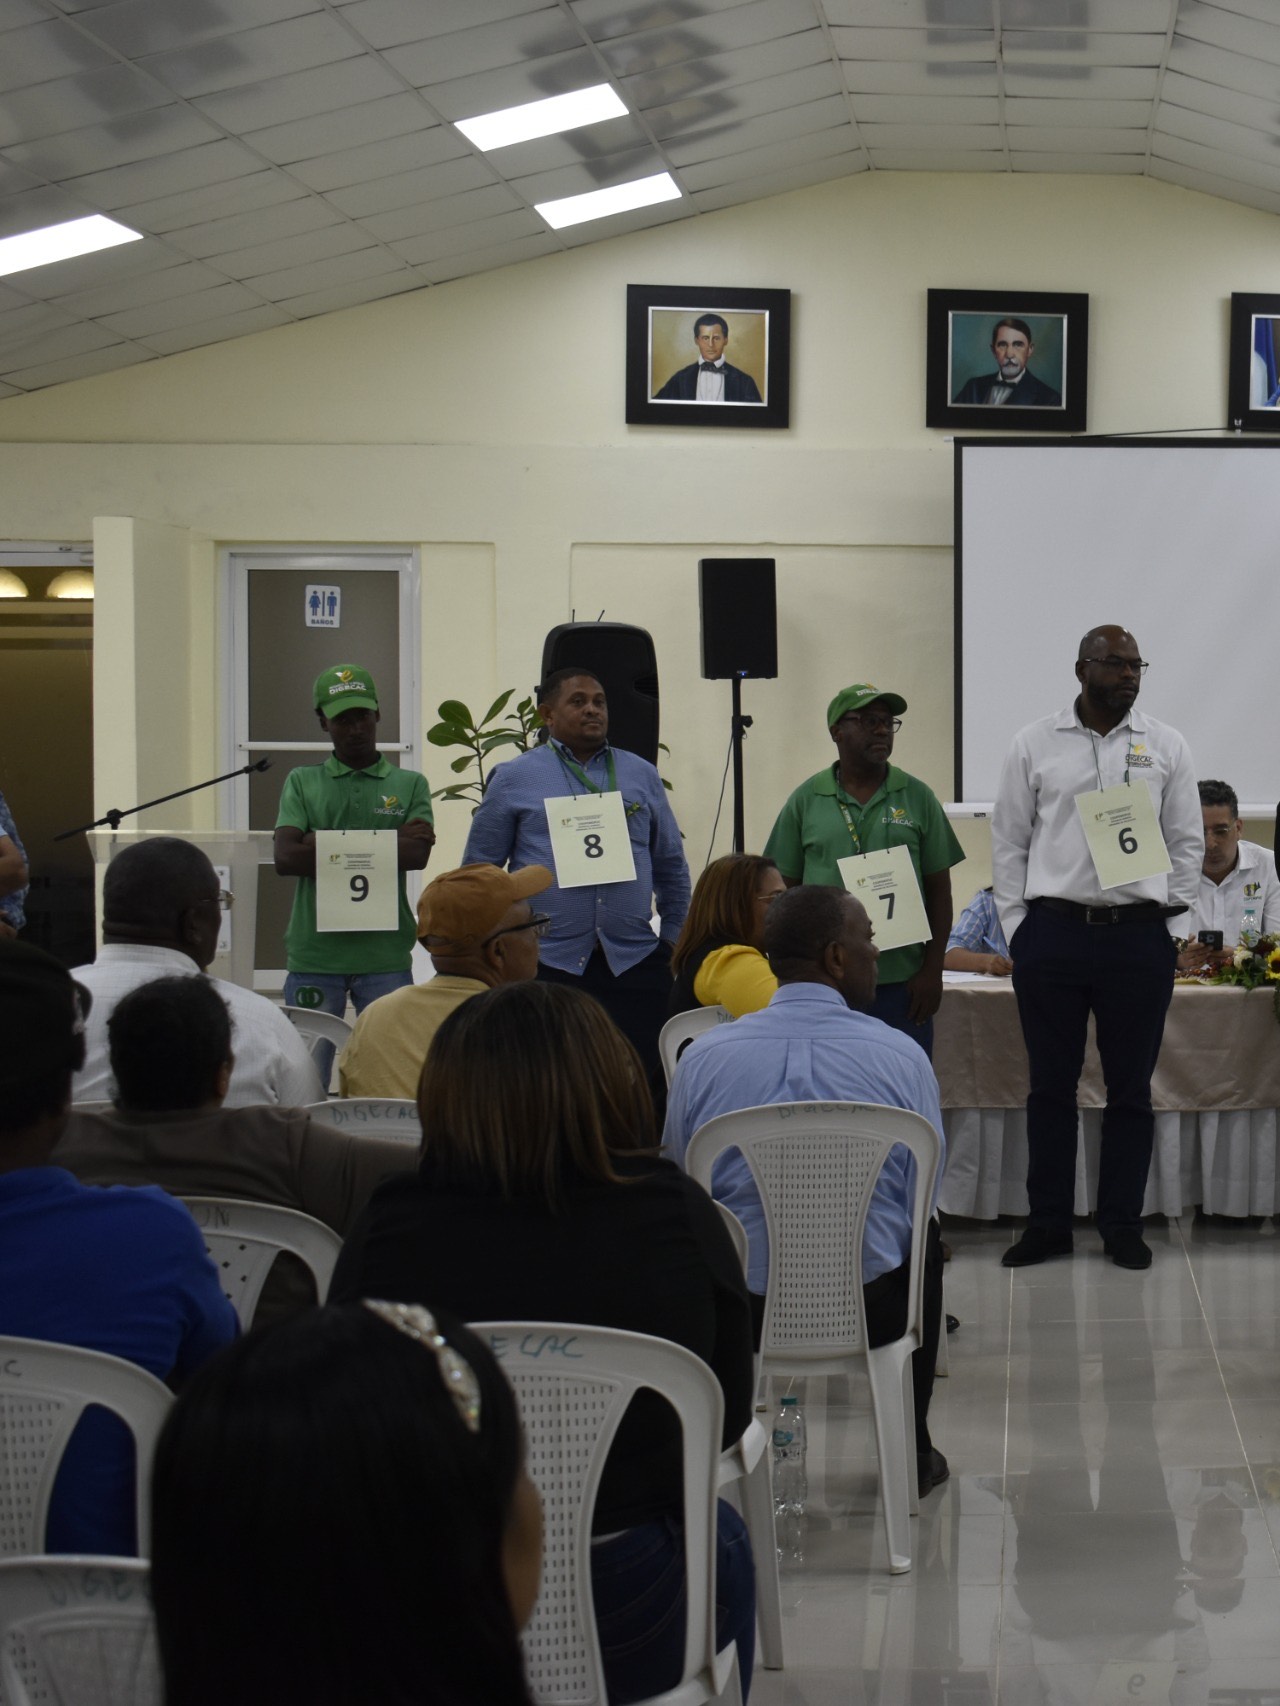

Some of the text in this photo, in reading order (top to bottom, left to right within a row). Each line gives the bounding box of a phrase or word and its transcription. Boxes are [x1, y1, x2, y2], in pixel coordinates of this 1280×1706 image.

[374, 807, 405, 816] DIGECAC
[583, 833, 604, 859] 8
[1118, 827, 1138, 855] 6
[349, 874, 370, 902] 9
[878, 892, 895, 920] 7
